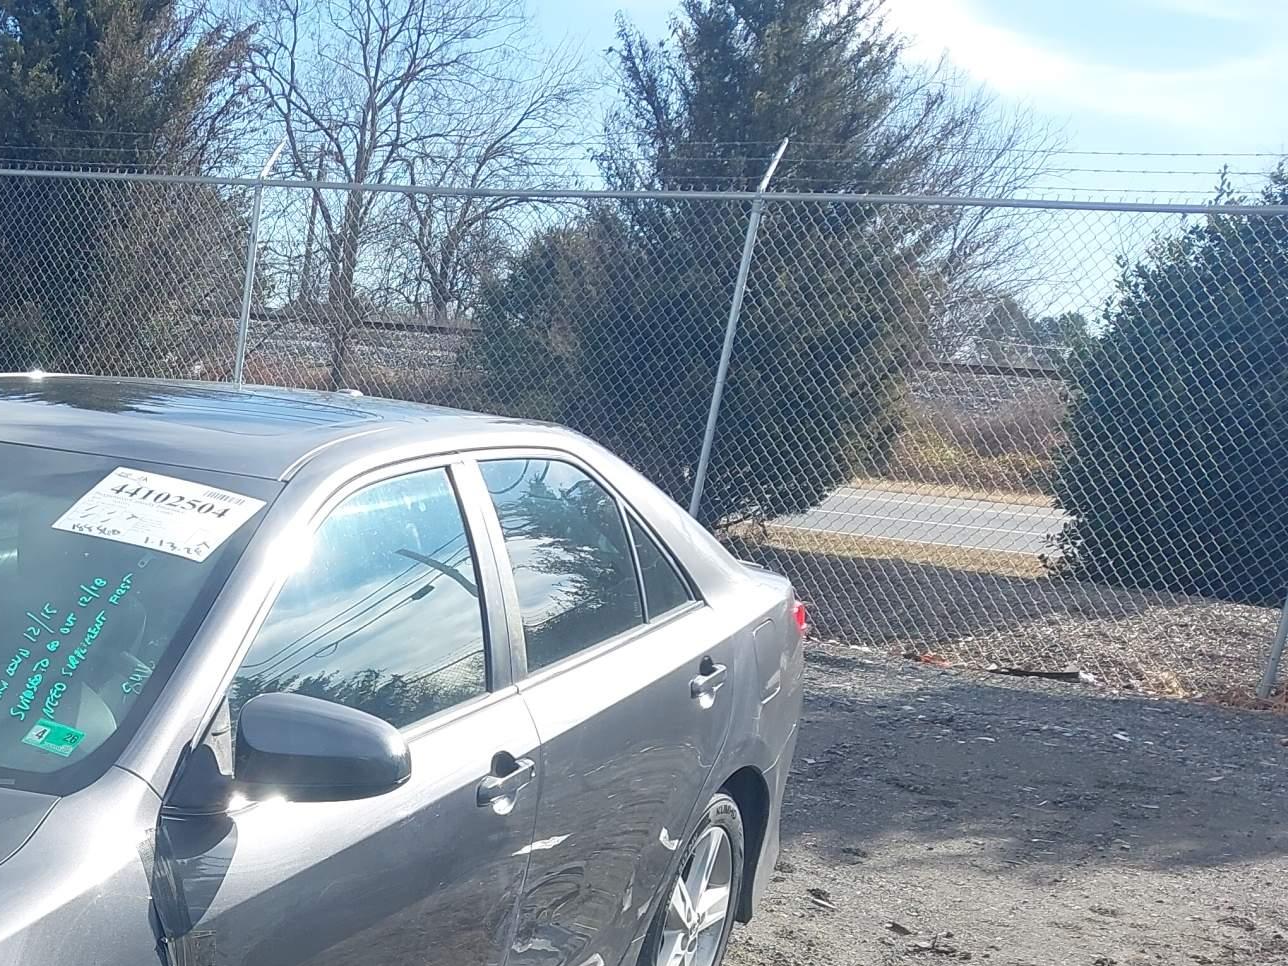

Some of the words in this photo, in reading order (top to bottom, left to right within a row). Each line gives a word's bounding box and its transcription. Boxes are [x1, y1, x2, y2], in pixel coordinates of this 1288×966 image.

[111, 483, 231, 518] 44102504
[23, 603, 57, 642] 12/15
[60, 613, 77, 635] OUT
[78, 577, 107, 606] 12/18
[35, 729, 46, 740] 4
[63, 732, 78, 744] 26
